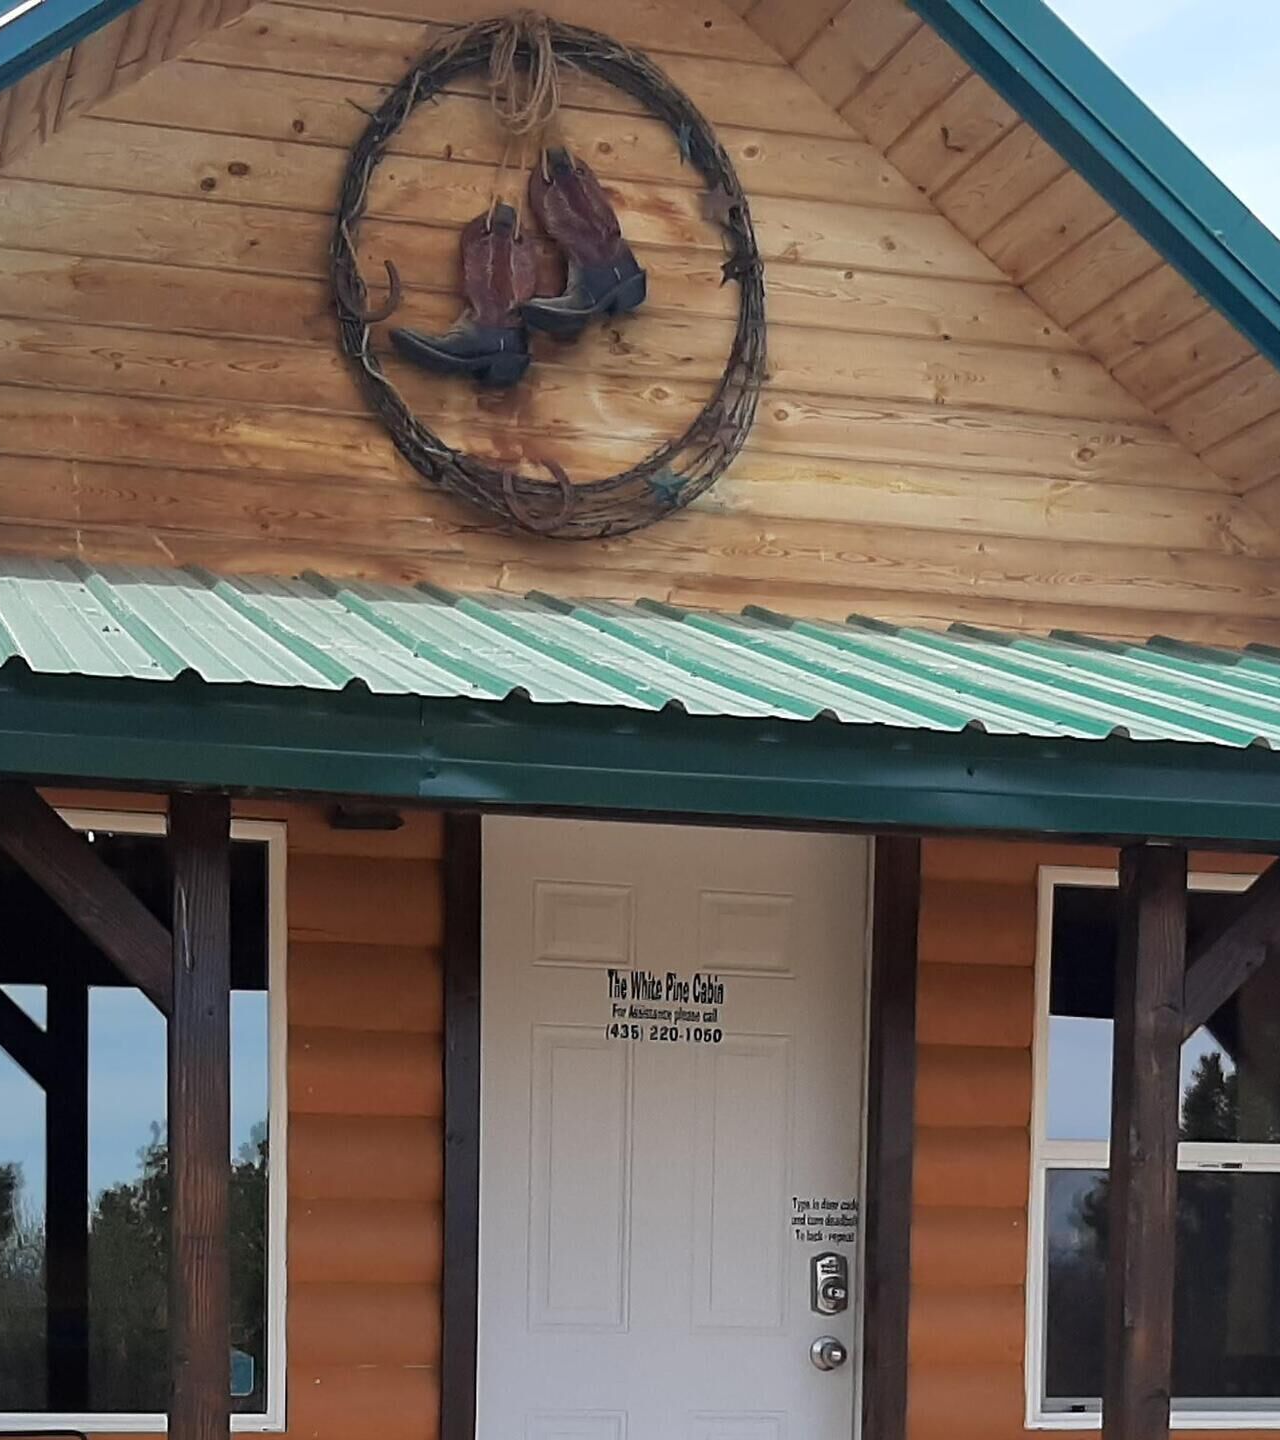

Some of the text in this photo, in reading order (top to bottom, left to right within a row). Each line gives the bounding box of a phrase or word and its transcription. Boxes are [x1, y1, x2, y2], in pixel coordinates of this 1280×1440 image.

[607, 969, 724, 1004] The White Pine Cabin
